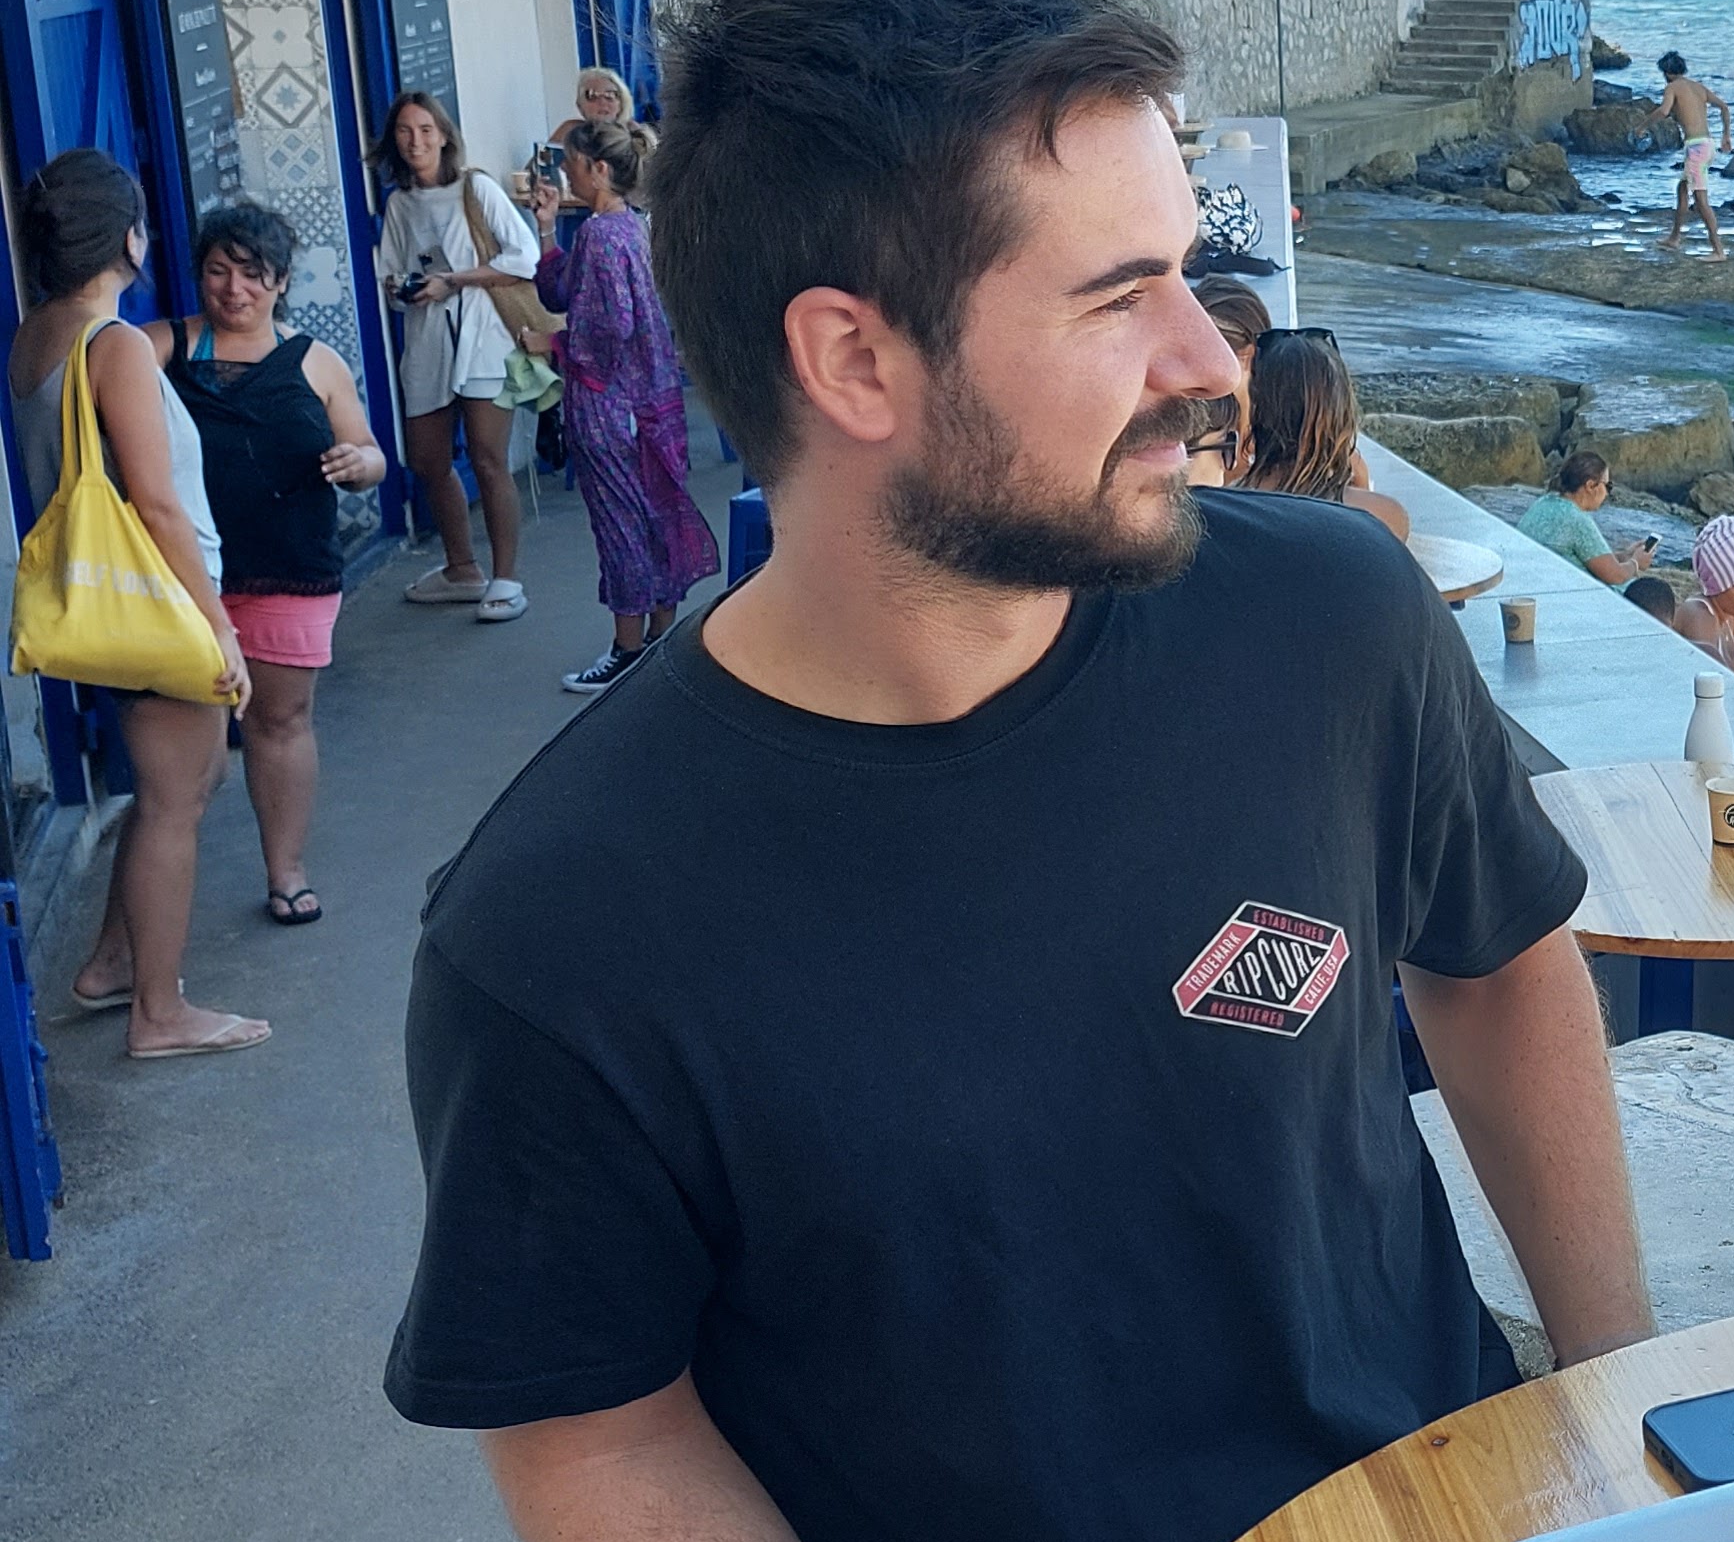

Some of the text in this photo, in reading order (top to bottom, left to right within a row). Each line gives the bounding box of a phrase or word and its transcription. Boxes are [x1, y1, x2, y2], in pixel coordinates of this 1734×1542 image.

[1253, 910, 1325, 941] ESTABLISHED
[1186, 931, 1242, 992] TRADEMARK
[1323, 954, 1339, 977] USA
[1209, 1002, 1285, 1028] REGISTERED
